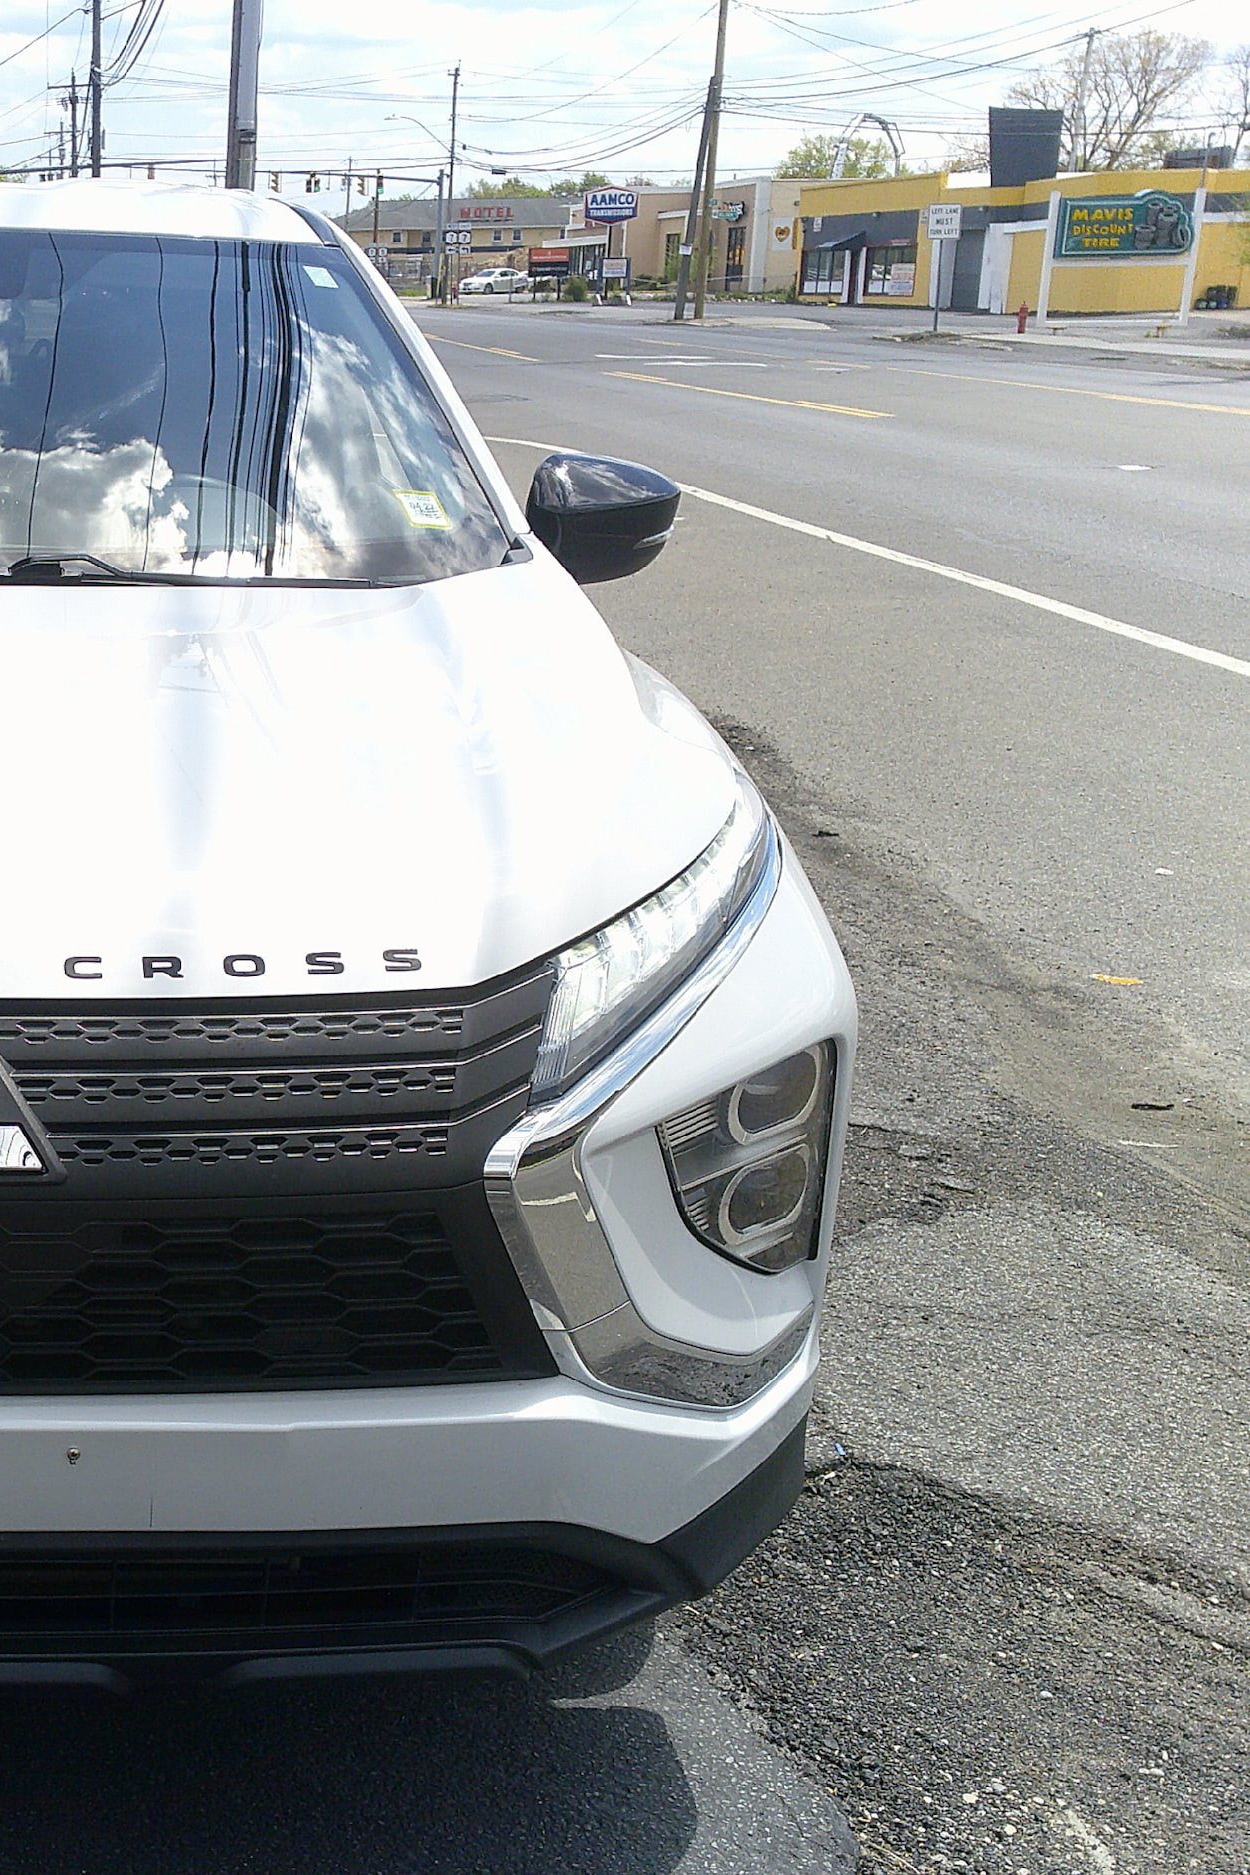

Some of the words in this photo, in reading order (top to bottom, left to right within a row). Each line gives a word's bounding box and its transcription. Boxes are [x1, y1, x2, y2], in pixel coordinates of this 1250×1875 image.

[590, 193, 635, 206] AAMCO
[460, 207, 514, 219] MOTEL
[1072, 208, 1134, 221] MAVIS
[935, 217, 953, 225] MUST
[1072, 223, 1134, 236] DISCOUNT
[1082, 237, 1120, 248] TIRE
[63, 948, 422, 980] CROSS
